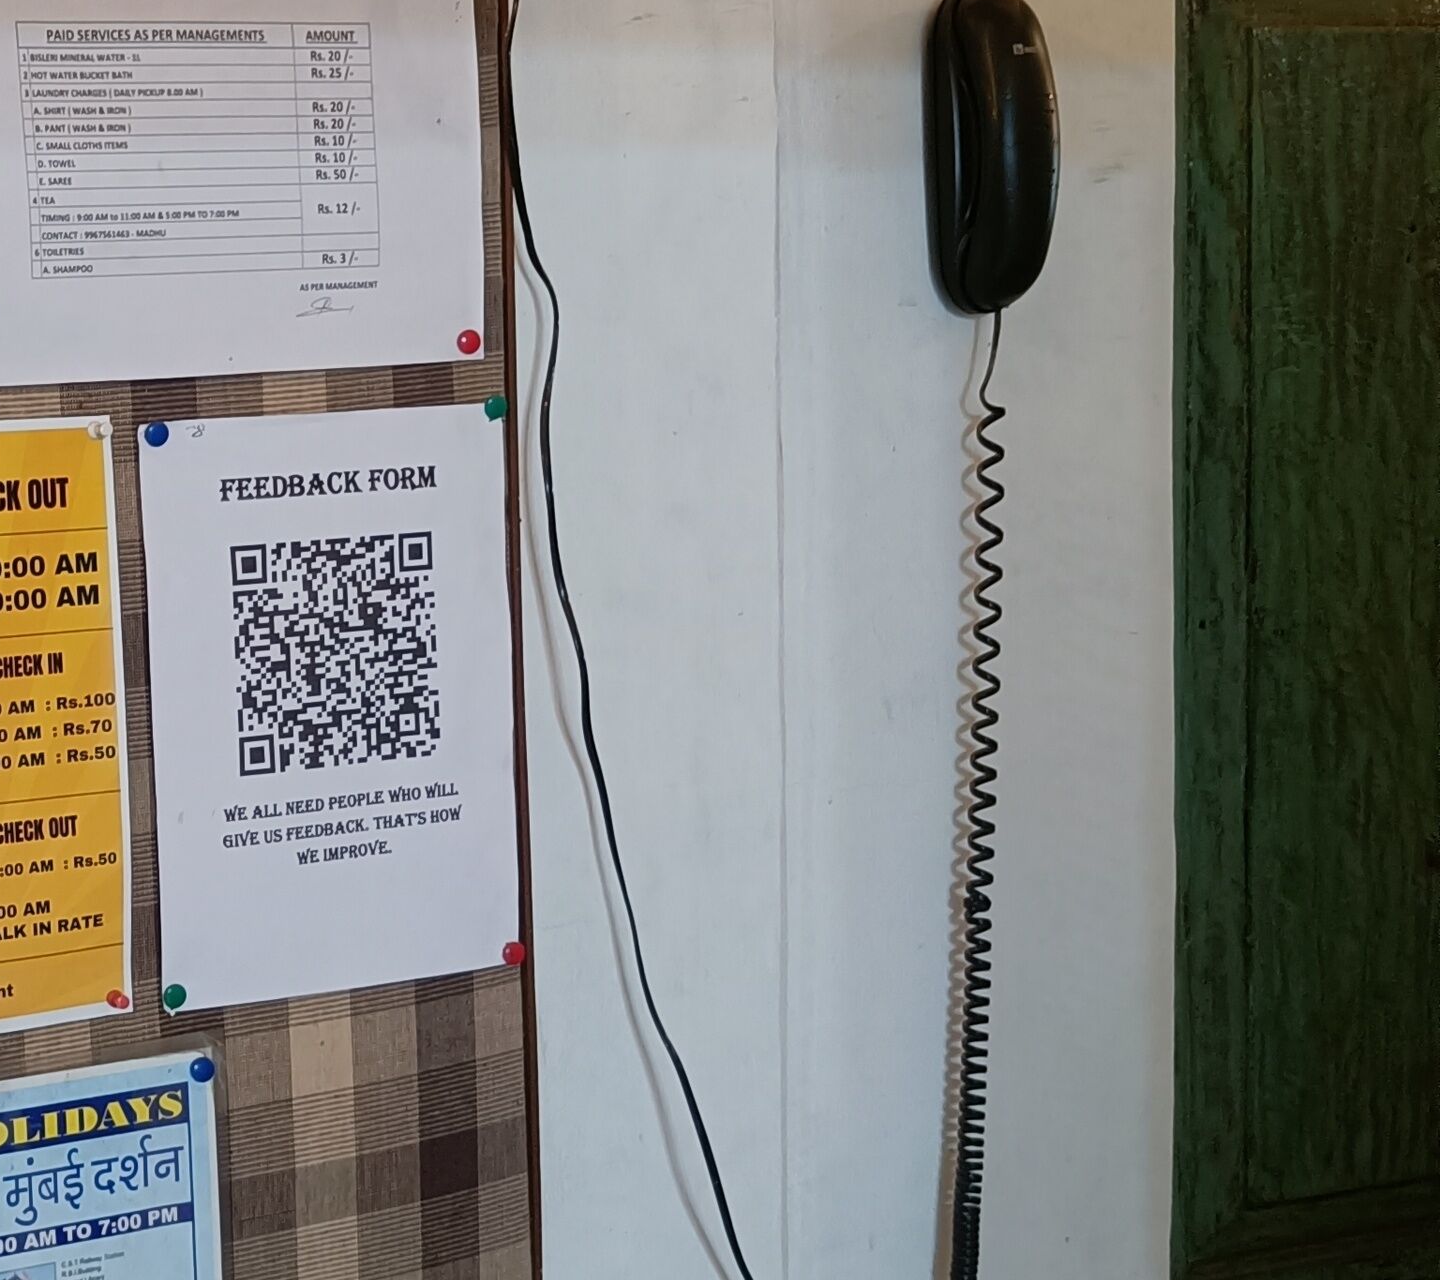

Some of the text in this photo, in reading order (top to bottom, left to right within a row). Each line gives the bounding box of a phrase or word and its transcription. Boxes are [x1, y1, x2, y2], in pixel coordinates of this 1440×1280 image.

[45, 28, 266, 43] PAID SERVICES AS PER MANAGEMENTS
[304, 29, 358, 44] AMOUNT
[310, 66, 327, 79] Rs.
[328, 66, 342, 79] 25
[313, 151, 330, 164] Rs.
[332, 150, 346, 163] 10
[41, 246, 85, 257] TOILETRIES
[41, 263, 94, 274] A. SHAMPOO
[26, 476, 69, 510] OUT
[218, 464, 437, 502] FEEDBACK FORM
[54, 550, 98, 575] AM
[46, 651, 63, 675] IN
[222, 781, 459, 822] WE ALL NEED PEOPLE WHO WILL
[221, 802, 462, 849] GIVE US FEEDBACK. THAT'S HOW
[1, 1134, 185, 1226] मुंबई दर्शन
[23, 1228, 57, 1250] AM
[61, 1222, 92, 1242] TO
[97, 1212, 142, 1235] 7:00
[147, 1205, 178, 1226] PM
